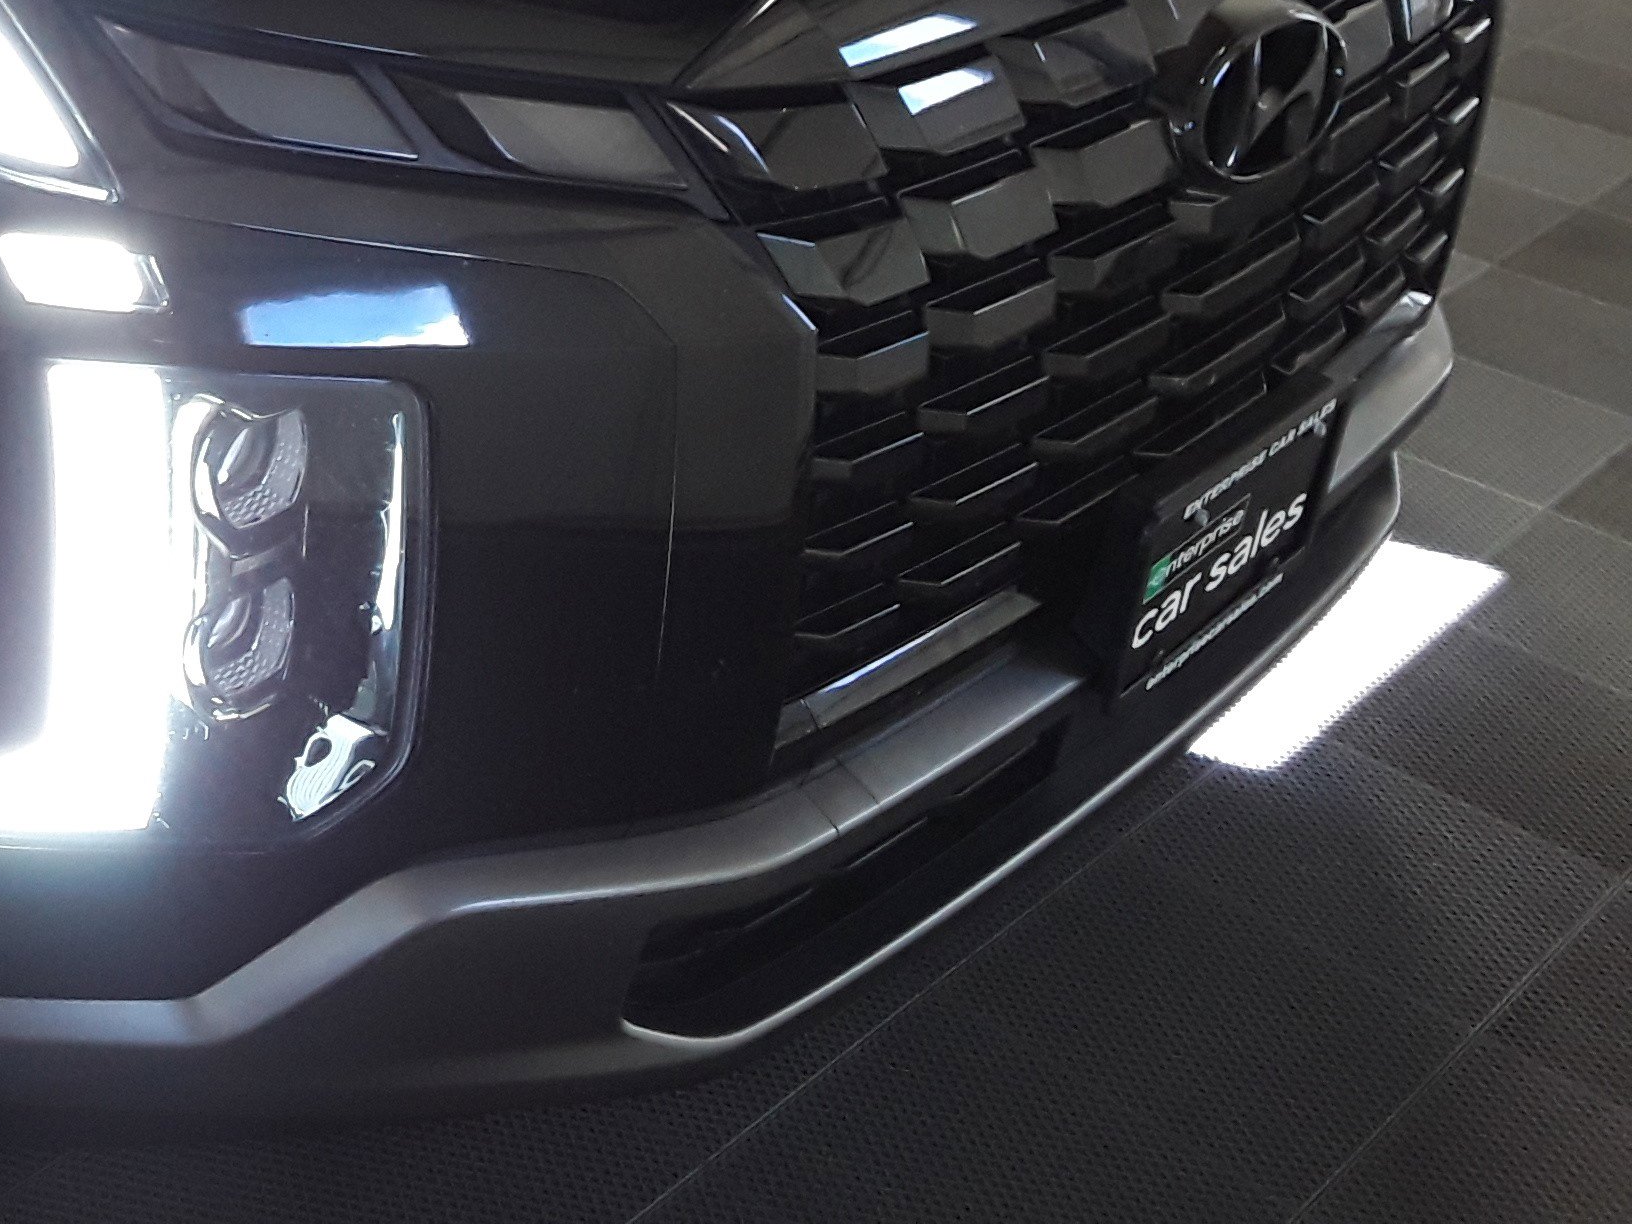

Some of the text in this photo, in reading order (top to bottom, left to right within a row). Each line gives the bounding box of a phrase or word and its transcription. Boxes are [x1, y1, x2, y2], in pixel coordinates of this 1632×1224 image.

[1131, 572, 1202, 649] car
[1205, 493, 1307, 592] sales
[1145, 509, 1245, 588] enterprise
